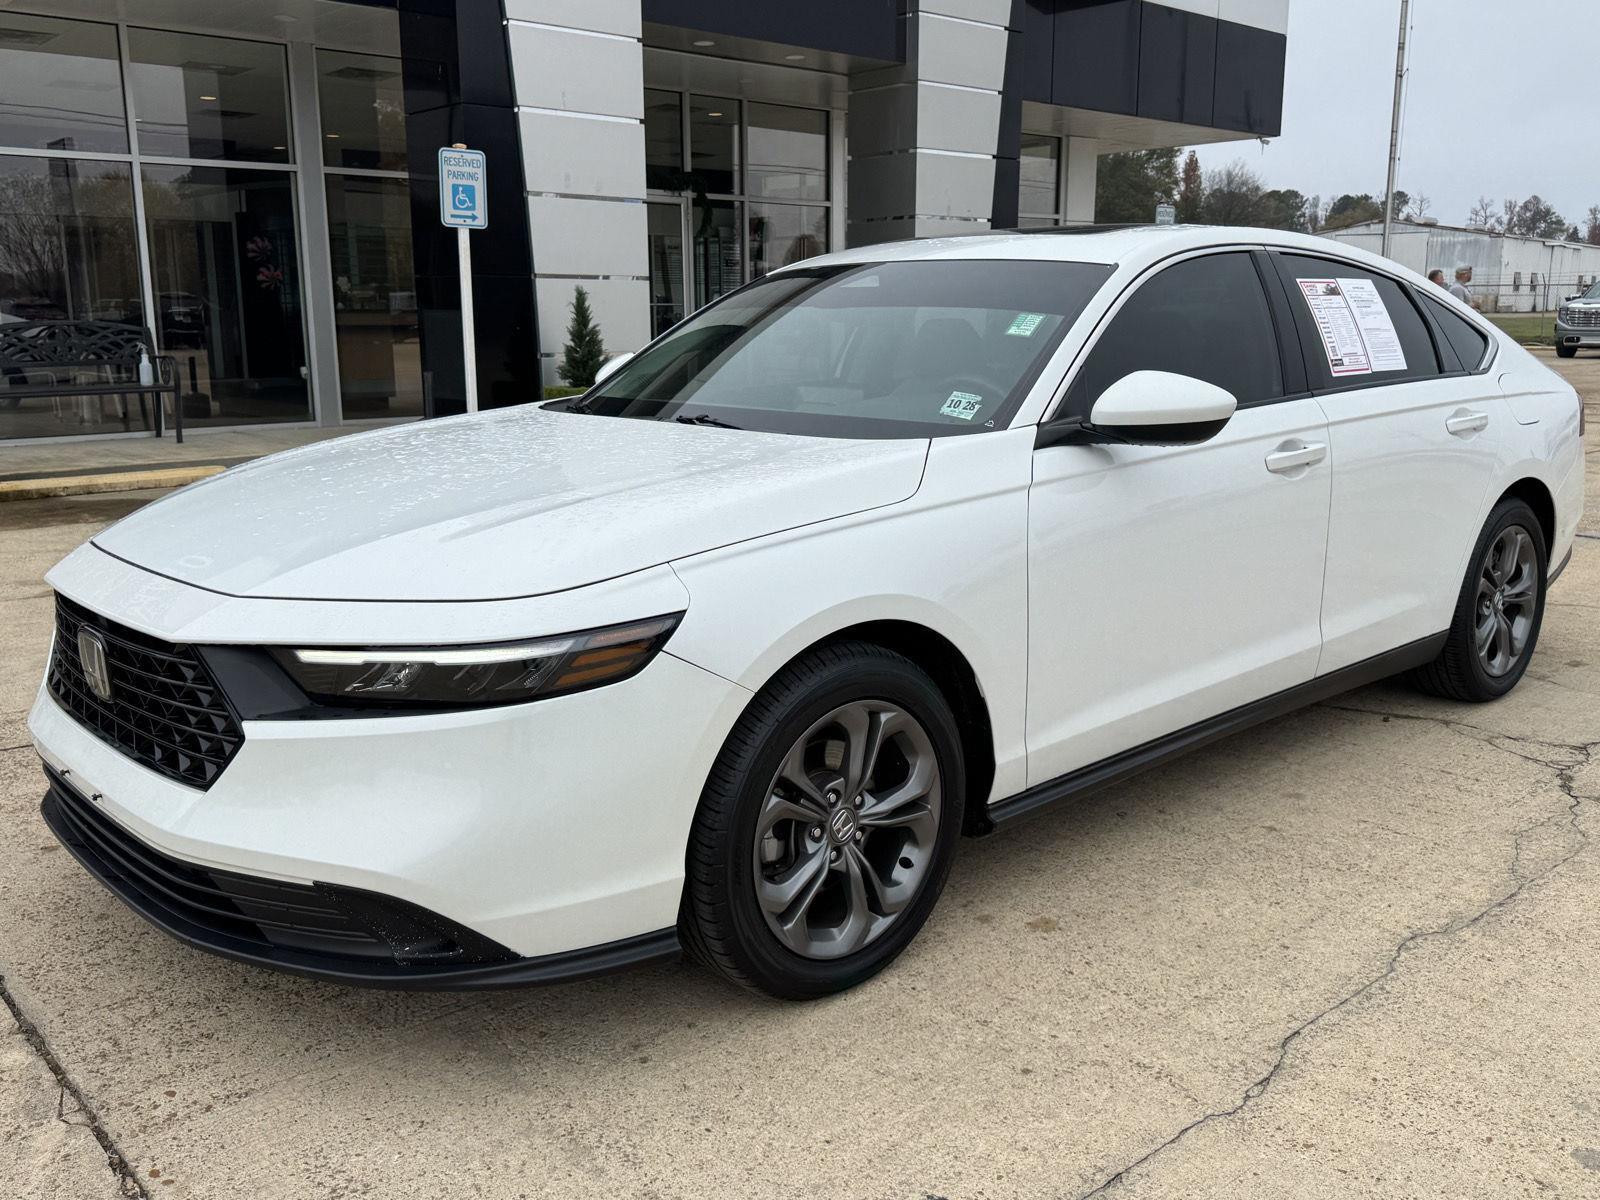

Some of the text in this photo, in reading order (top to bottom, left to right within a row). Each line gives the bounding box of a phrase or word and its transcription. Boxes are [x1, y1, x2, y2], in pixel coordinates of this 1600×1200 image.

[443, 156, 482, 169] RESERVED
[447, 170, 479, 182] PARKING
[946, 398, 962, 409] 10
